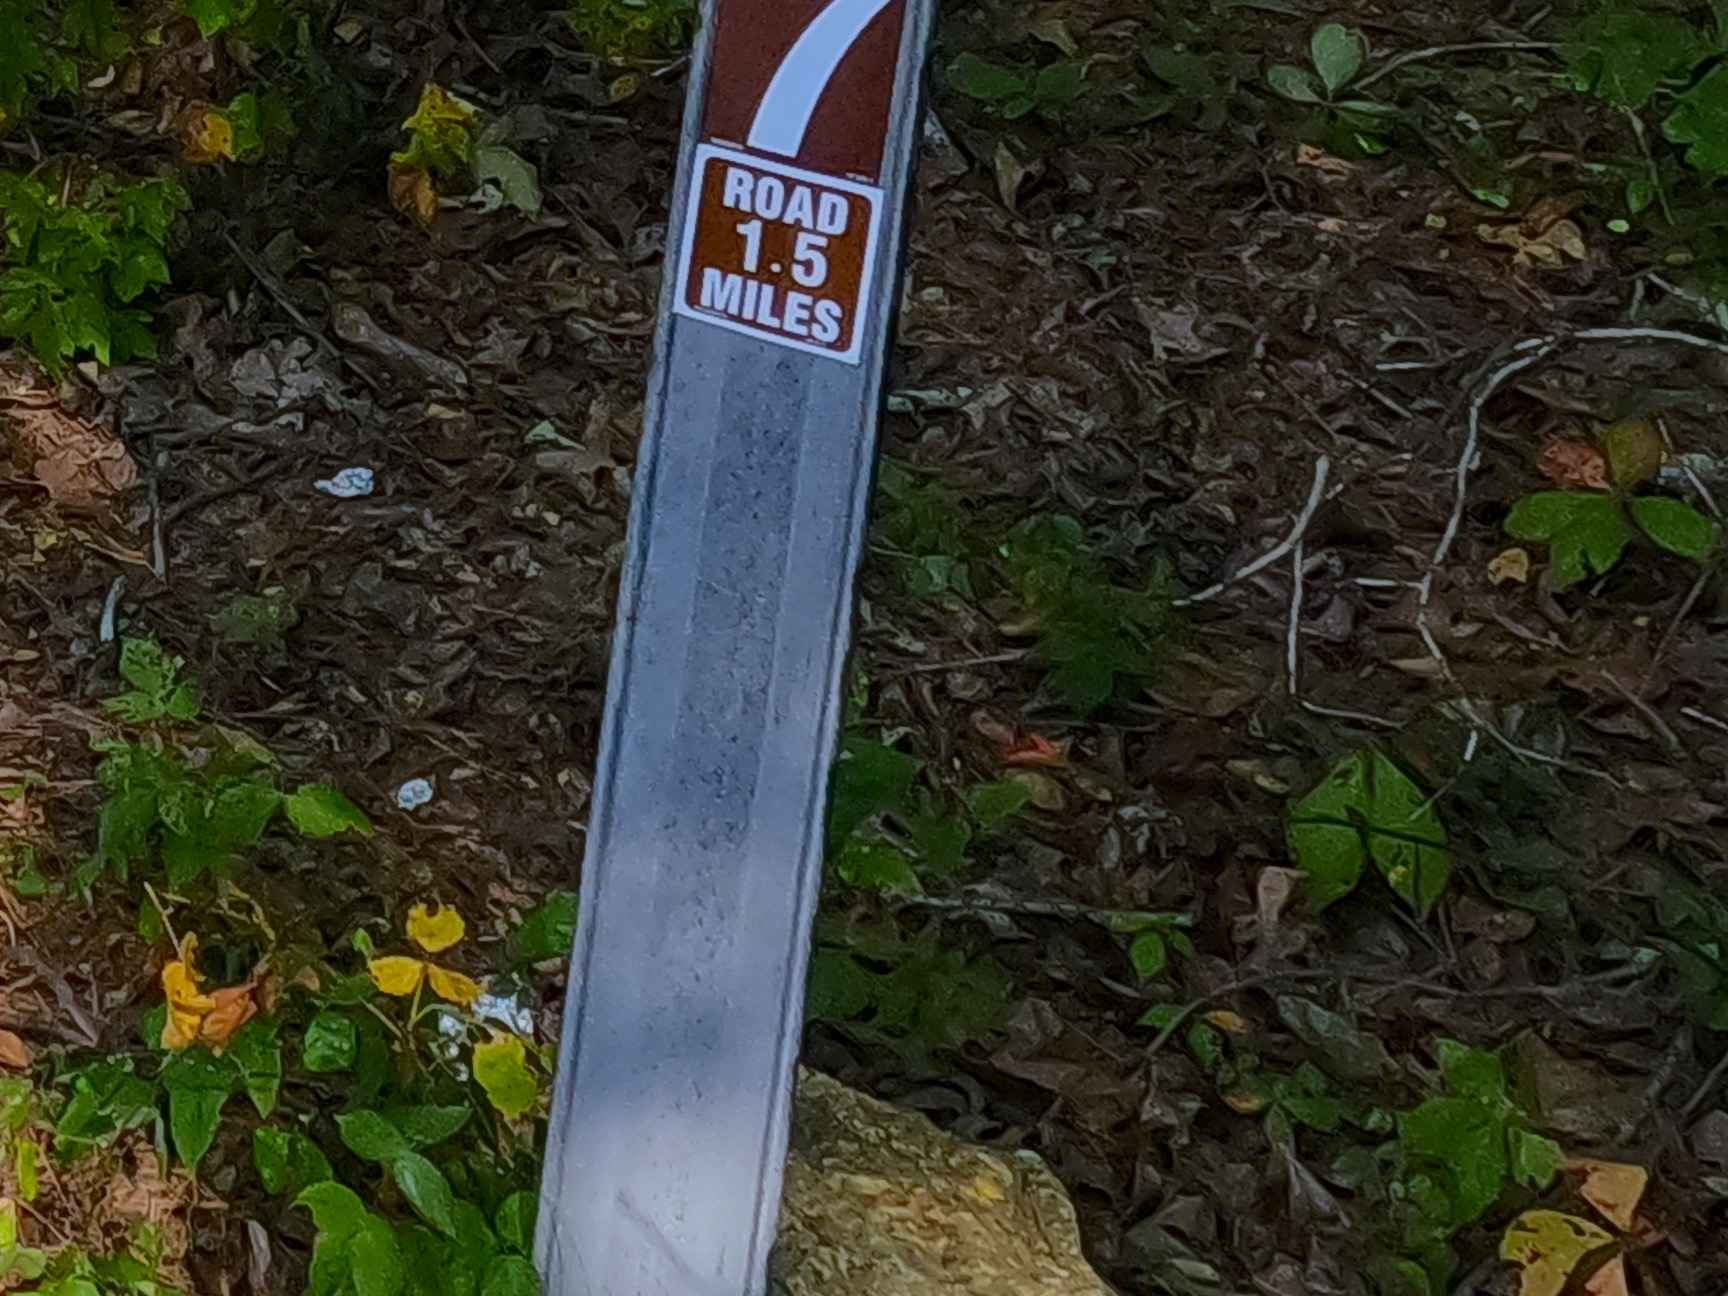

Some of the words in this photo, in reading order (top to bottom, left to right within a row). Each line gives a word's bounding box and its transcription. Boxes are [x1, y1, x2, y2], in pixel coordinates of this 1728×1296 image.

[723, 167, 848, 236] ROAD
[736, 219, 828, 287] 1.5
[699, 268, 843, 343] MILES
